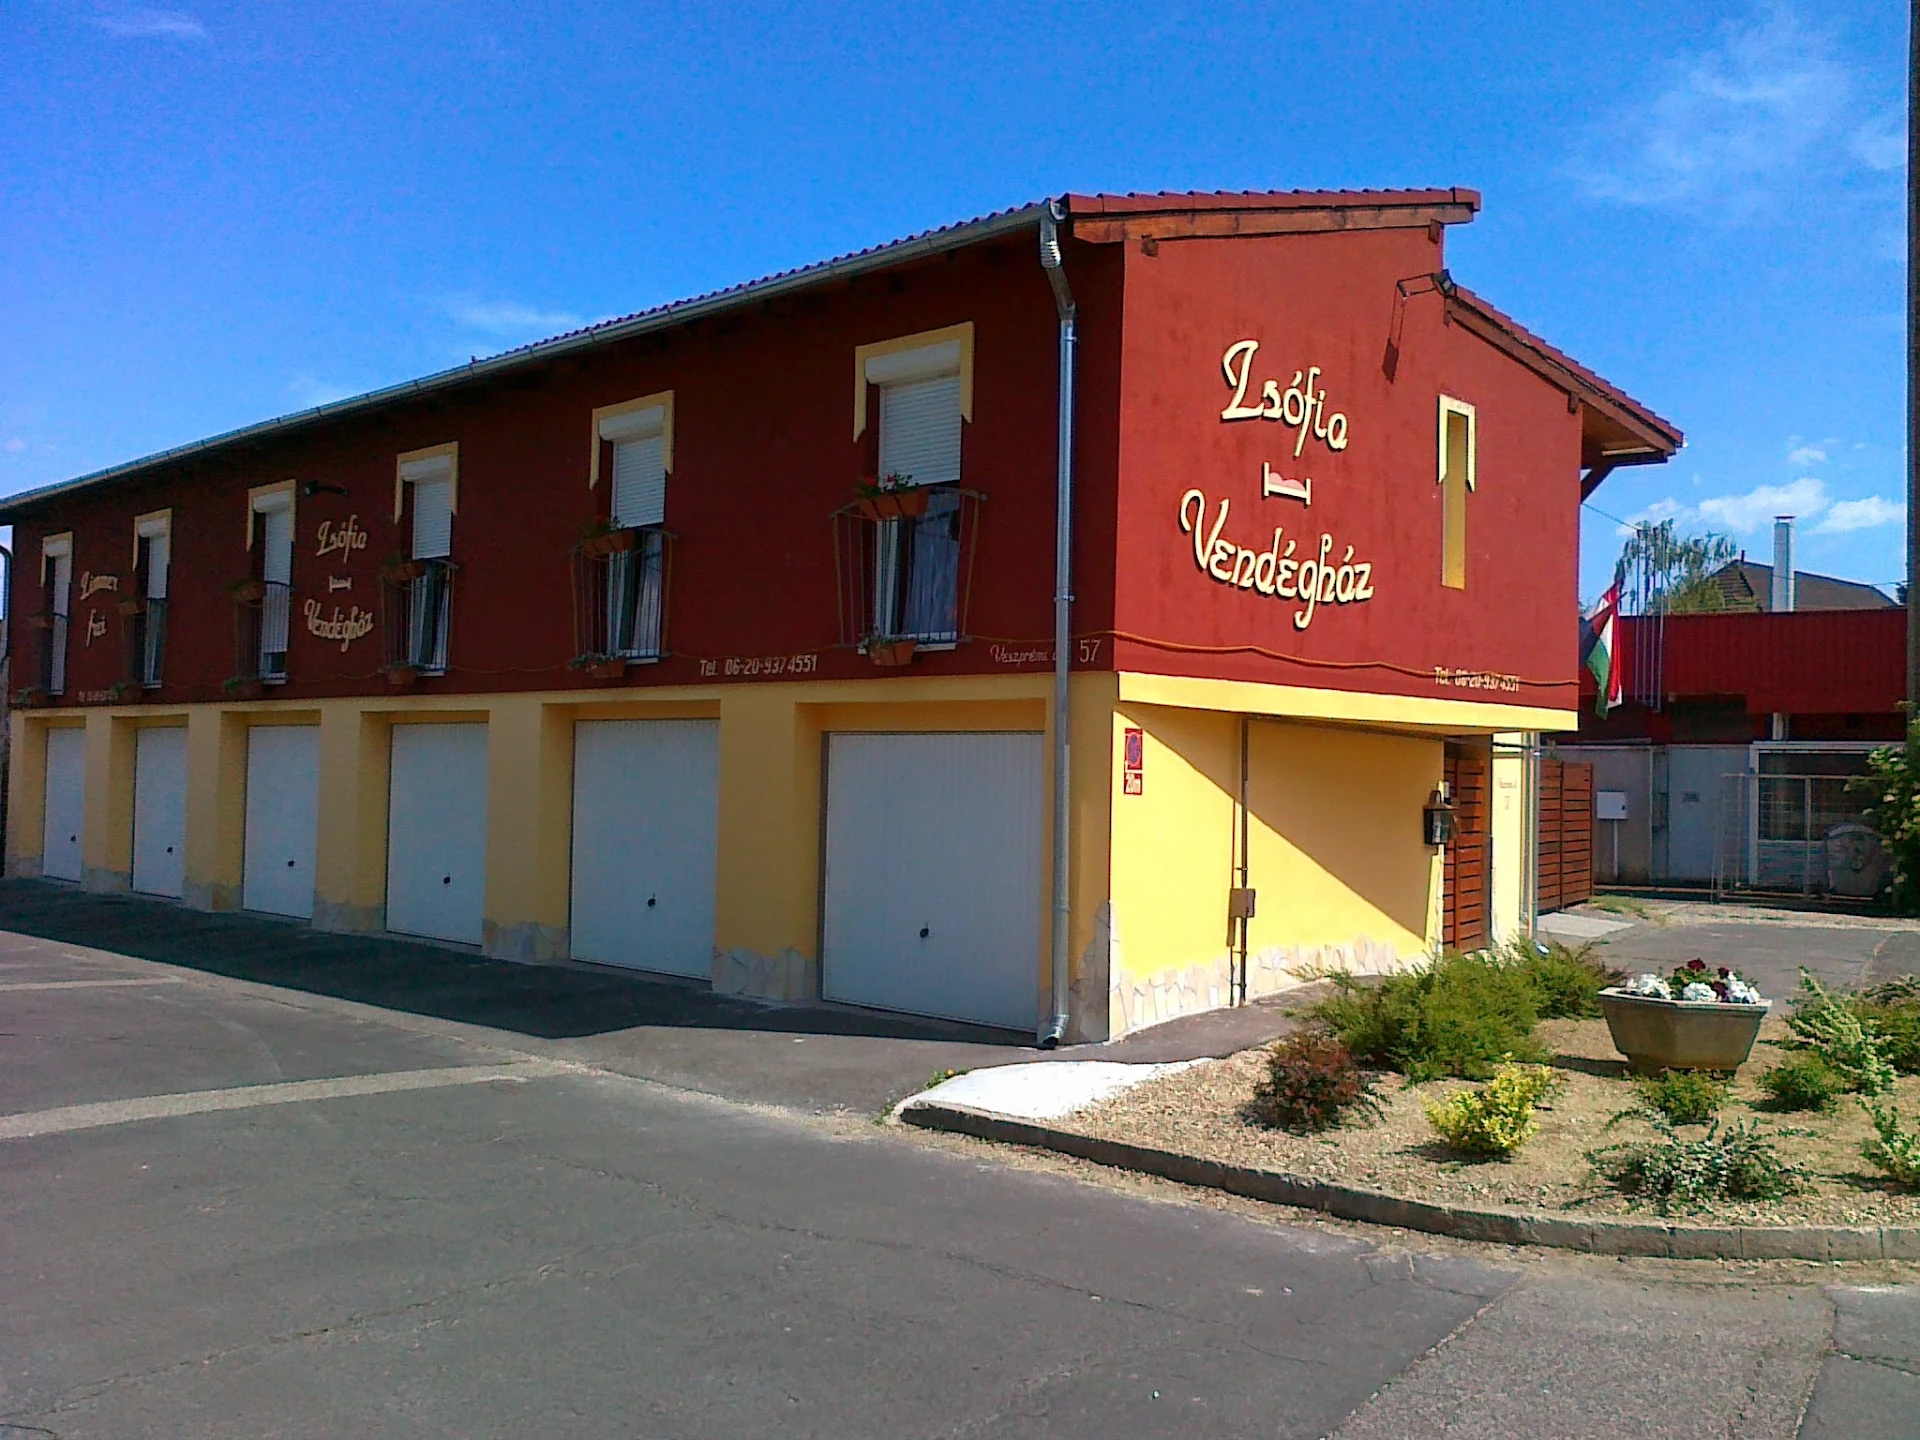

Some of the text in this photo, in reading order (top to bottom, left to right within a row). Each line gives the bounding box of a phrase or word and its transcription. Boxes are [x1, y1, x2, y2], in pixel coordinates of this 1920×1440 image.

[1219, 338, 1349, 458] Zsófia
[315, 513, 368, 564] Zsófia
[1180, 488, 1375, 629] Vendégház
[303, 598, 374, 653] Vendégház
[1079, 638, 1102, 663] 57
